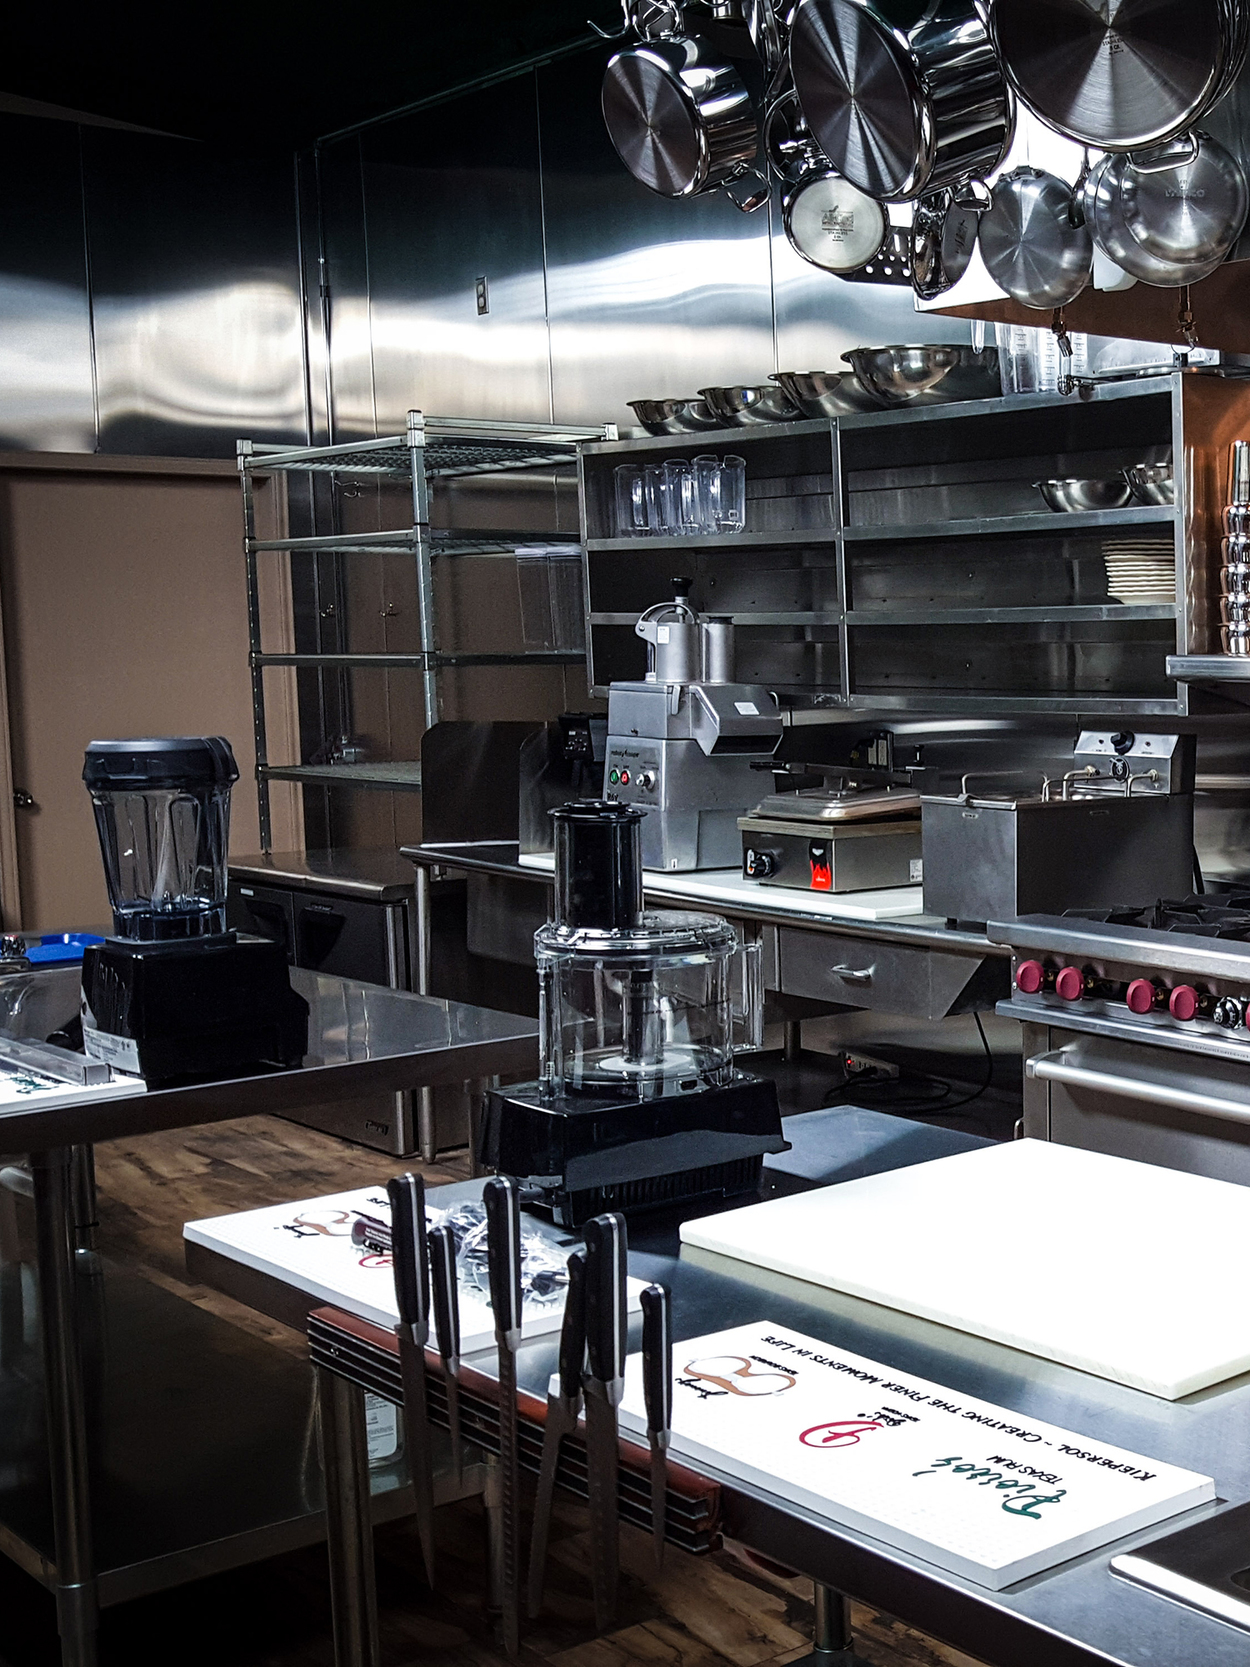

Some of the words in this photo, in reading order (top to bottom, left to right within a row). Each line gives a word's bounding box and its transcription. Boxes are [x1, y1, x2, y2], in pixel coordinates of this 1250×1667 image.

[760, 1335, 796, 1351] LIFE
[791, 1348, 813, 1357] IN
[809, 1355, 884, 1384] MOMENTS
[881, 1381, 931, 1402] FINER
[927, 1398, 962, 1414] THE
[961, 1411, 1043, 1443] CREATING
[1057, 1443, 1157, 1482] KIEPERSOL
[1018, 1466, 1063, 1485] TEXAS
